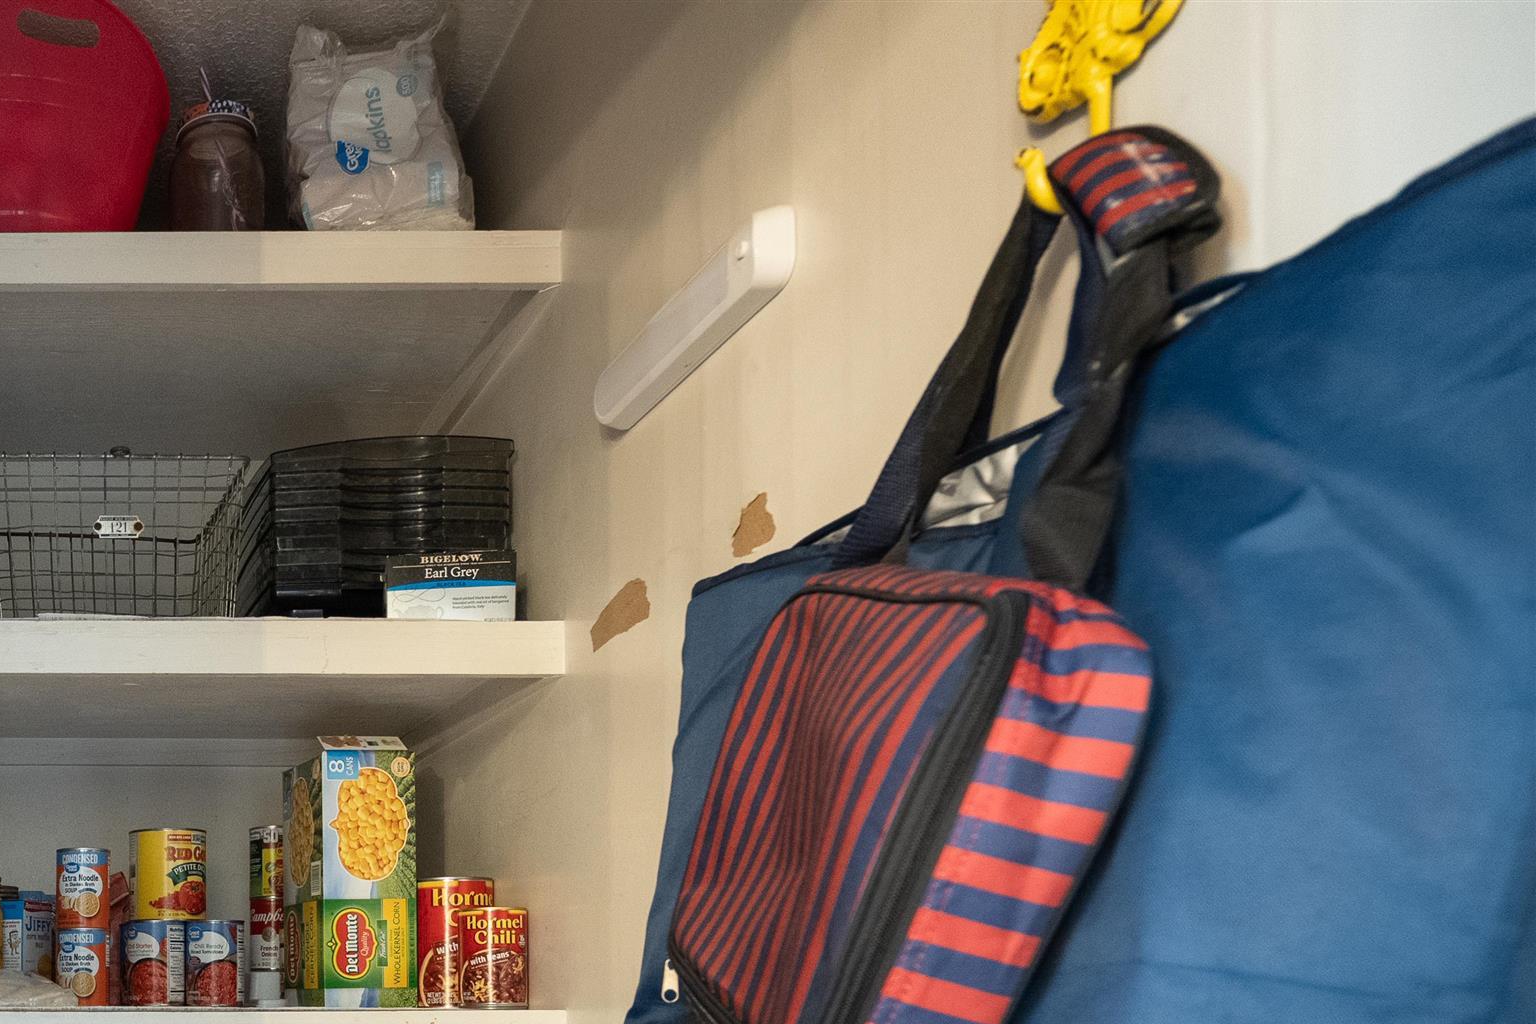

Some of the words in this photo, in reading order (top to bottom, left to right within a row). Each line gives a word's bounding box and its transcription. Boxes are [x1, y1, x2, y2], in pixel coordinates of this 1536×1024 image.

[111, 521, 127, 533] 121
[420, 553, 480, 564] BIGELOW
[424, 567, 448, 579] Earl
[450, 566, 479, 580] Grey
[328, 760, 344, 772] 8
[62, 853, 99, 865] CONDENSED
[167, 846, 192, 862] RED
[173, 863, 197, 875] PETITE
[62, 874, 77, 882] Extra
[78, 873, 99, 882] Noodle
[392, 901, 400, 925] CORN
[25, 915, 51, 932] JIFFY
[466, 914, 523, 930] Hormel
[58, 933, 95, 944] CONDENSED
[345, 913, 359, 953] Monte
[474, 929, 517, 945] Chili
[393, 926, 401, 955] KERNEL
[59, 954, 73, 962] Extra
[73, 953, 95, 961] Noodle
[345, 954, 359, 974] Del
[469, 954, 486, 966] with
[393, 955, 401, 985] WHOLE
